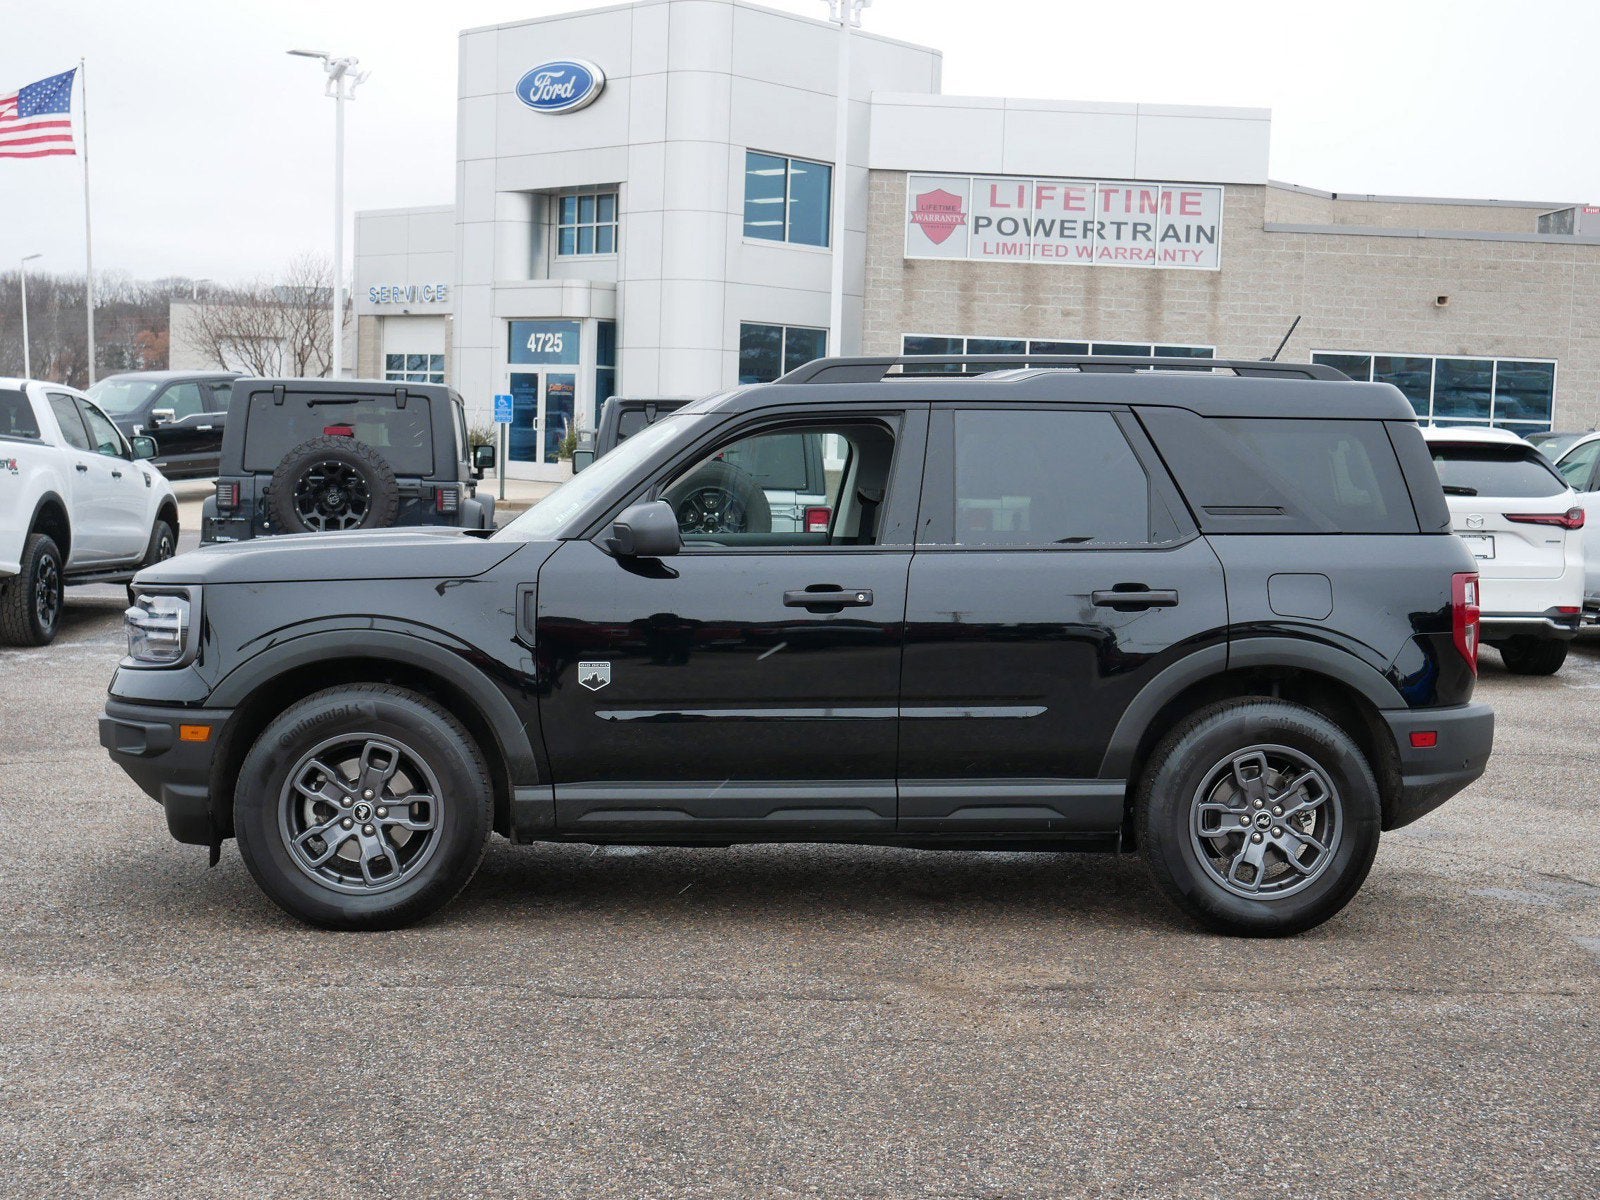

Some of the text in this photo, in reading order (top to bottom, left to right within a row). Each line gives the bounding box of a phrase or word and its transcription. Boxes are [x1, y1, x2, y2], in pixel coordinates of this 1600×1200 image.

[529, 70, 577, 102] Ford
[921, 203, 957, 211] LIFETIME
[988, 183, 1203, 217] LIFETIME
[914, 212, 963, 223] WARRANTY
[973, 215, 1216, 244] POWERTRAIN
[983, 241, 1204, 263] LIMITED WARRANTY
[369, 284, 446, 303] SERVICE
[526, 332, 563, 353] 4725
